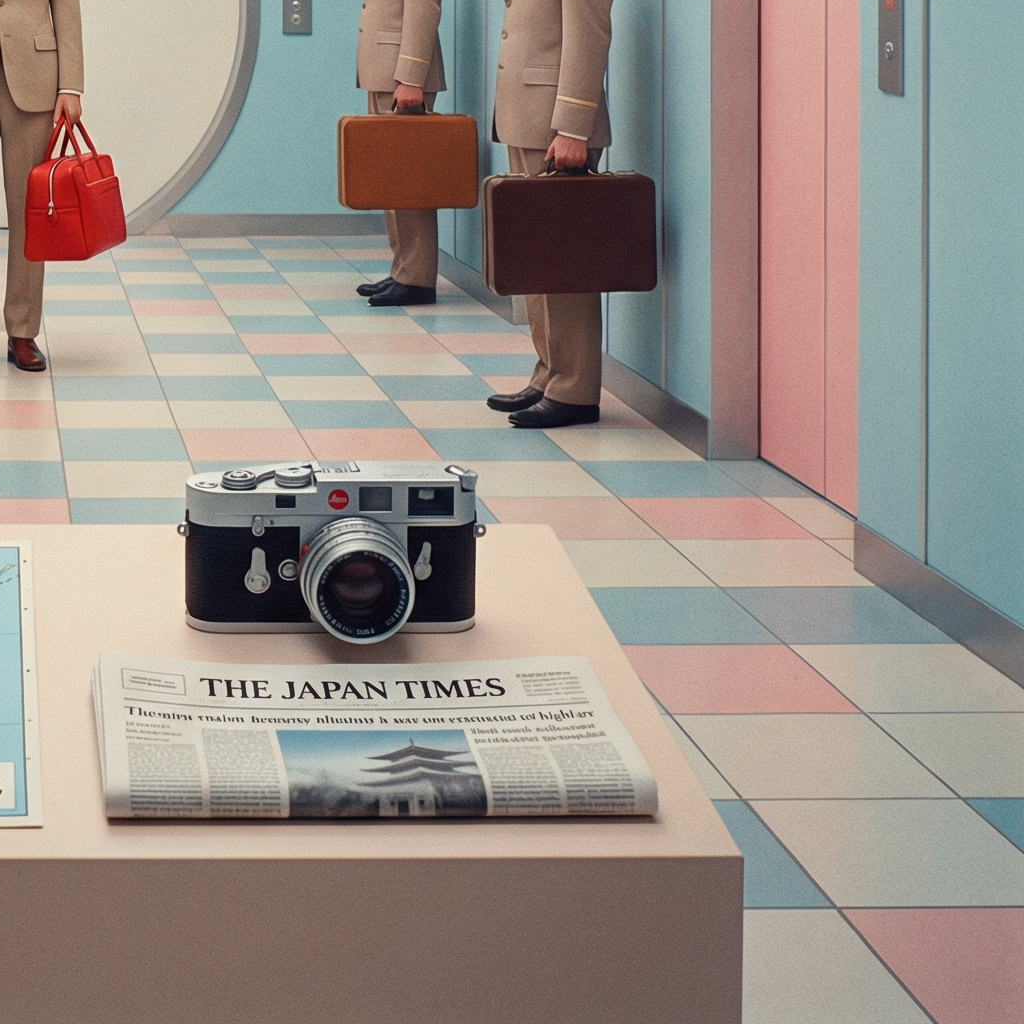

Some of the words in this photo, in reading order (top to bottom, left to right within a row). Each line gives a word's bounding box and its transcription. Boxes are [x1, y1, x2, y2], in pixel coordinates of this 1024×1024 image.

[199, 677, 272, 700] THE
[281, 679, 389, 700] JAPAN
[395, 677, 507, 700] TIMES
